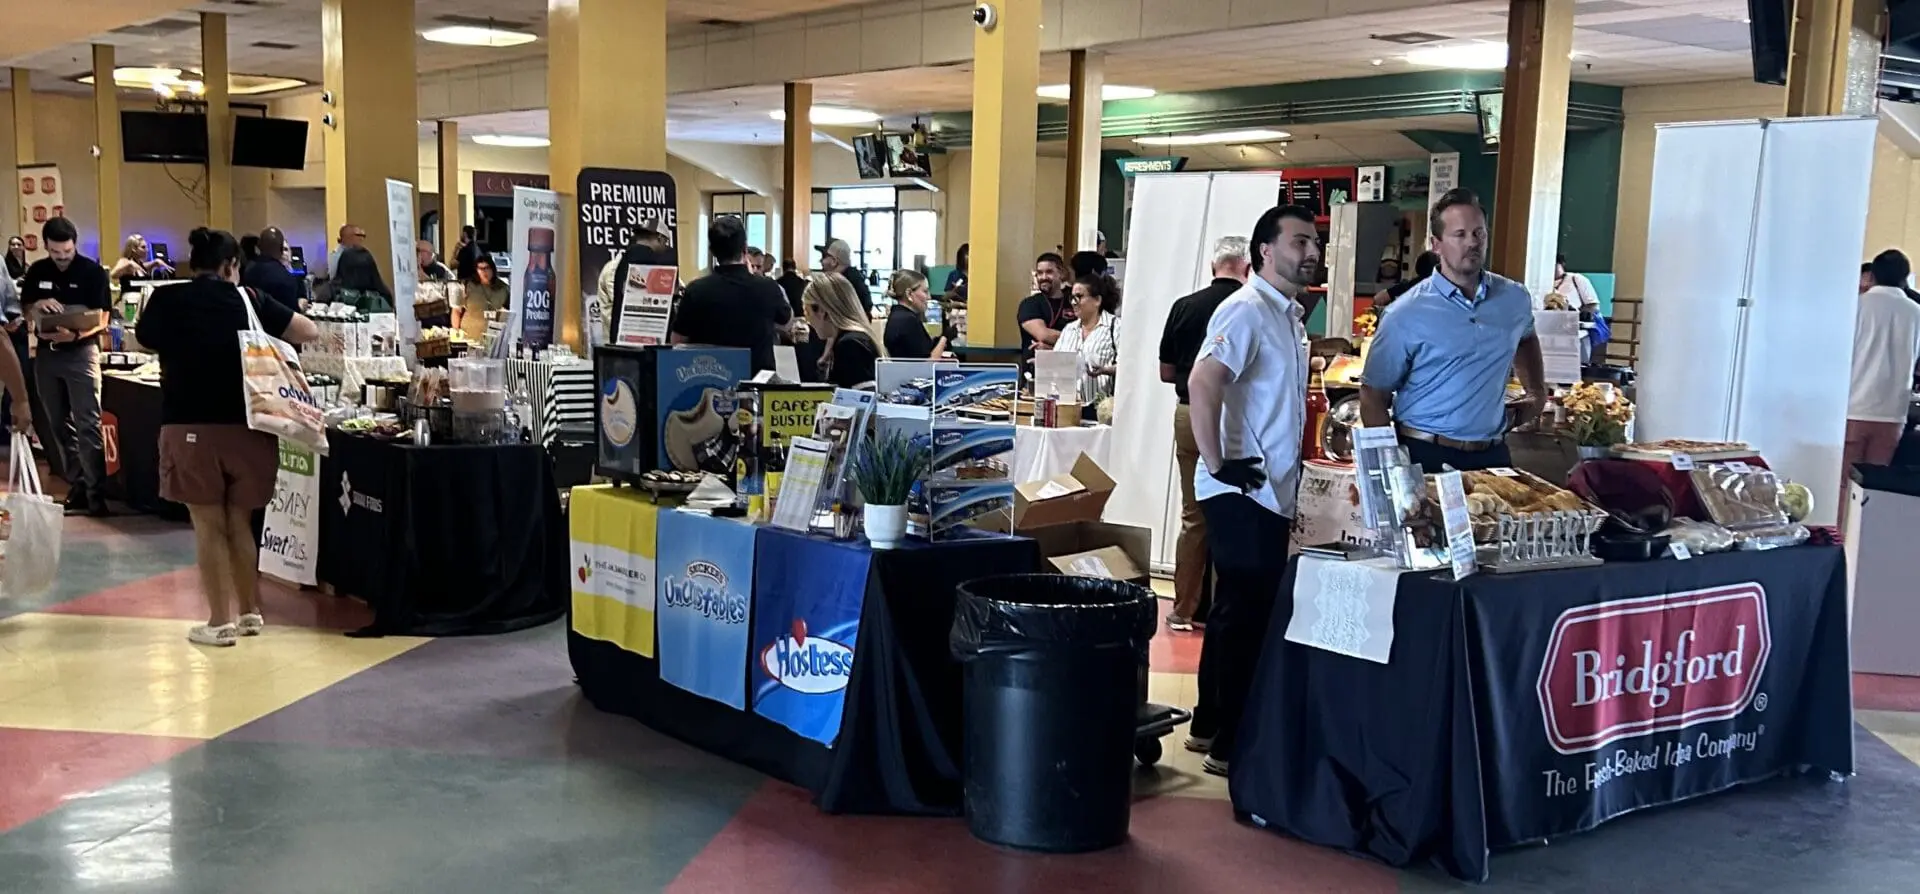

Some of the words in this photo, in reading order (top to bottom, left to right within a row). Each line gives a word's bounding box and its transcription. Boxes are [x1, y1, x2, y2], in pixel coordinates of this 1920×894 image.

[590, 182, 666, 205] PREMIUM
[582, 204, 621, 224] SOFT
[587, 226, 614, 246] ICE
[526, 290, 550, 309] 20G
[775, 633, 852, 680] Hostess
[1572, 624, 1746, 708] Bridgford
[1542, 770, 1577, 797] The
